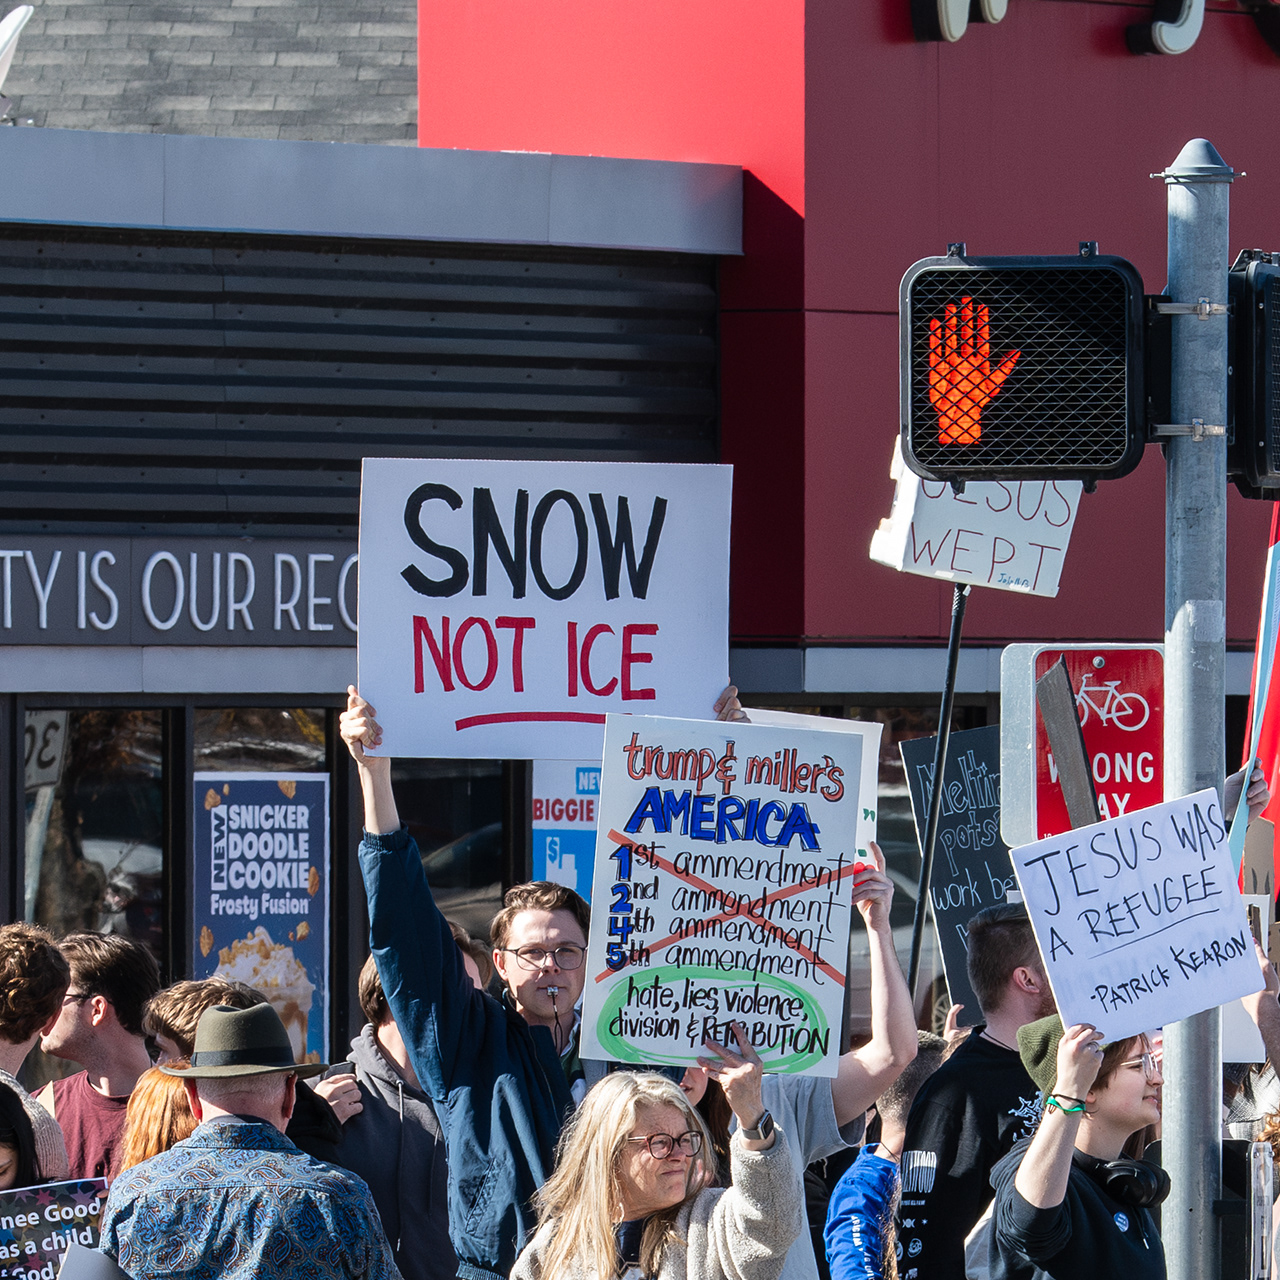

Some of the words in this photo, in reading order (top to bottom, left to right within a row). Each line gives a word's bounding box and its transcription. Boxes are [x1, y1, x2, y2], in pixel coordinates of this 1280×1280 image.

[400, 483, 668, 601] SNOW
[911, 522, 1062, 591] WEPT
[77, 550, 119, 631] IS
[141, 550, 255, 631] OUR
[413, 615, 536, 693] NOT
[567, 621, 660, 700] ICE
[623, 732, 715, 795] trump
[228, 804, 310, 830] SNICKER
[533, 798, 594, 822] BIGGIE
[624, 786, 821, 852] AMERICA
[1095, 793, 1130, 820] AY
[213, 812, 225, 883] NEW
[228, 831, 310, 860] DOODLE
[609, 841, 666, 882] 1st
[673, 850, 851, 896] ammendment
[1024, 821, 1163, 916] JESUS
[1170, 803, 1226, 861] WAS
[228, 861, 310, 890] COOKIE
[933, 868, 981, 910] work
[210, 893, 259, 921] Frosty
[261, 891, 309, 915] Fusion
[611, 875, 659, 915] 2nd
[671, 887, 847, 933] ammendment
[1049, 927, 1073, 962] A
[1077, 866, 1222, 943] REFUGEE
[606, 939, 651, 971] 5th
[608, 906, 655, 944] 4th
[669, 916, 835, 963] ammendment
[1170, 930, 1247, 980] KEARON
[627, 975, 680, 1013] hate,
[609, 1008, 680, 1041] division
[44, 1197, 101, 1222] Good
[24, 1240, 37, 1255] a
[41, 1225, 93, 1252] child
